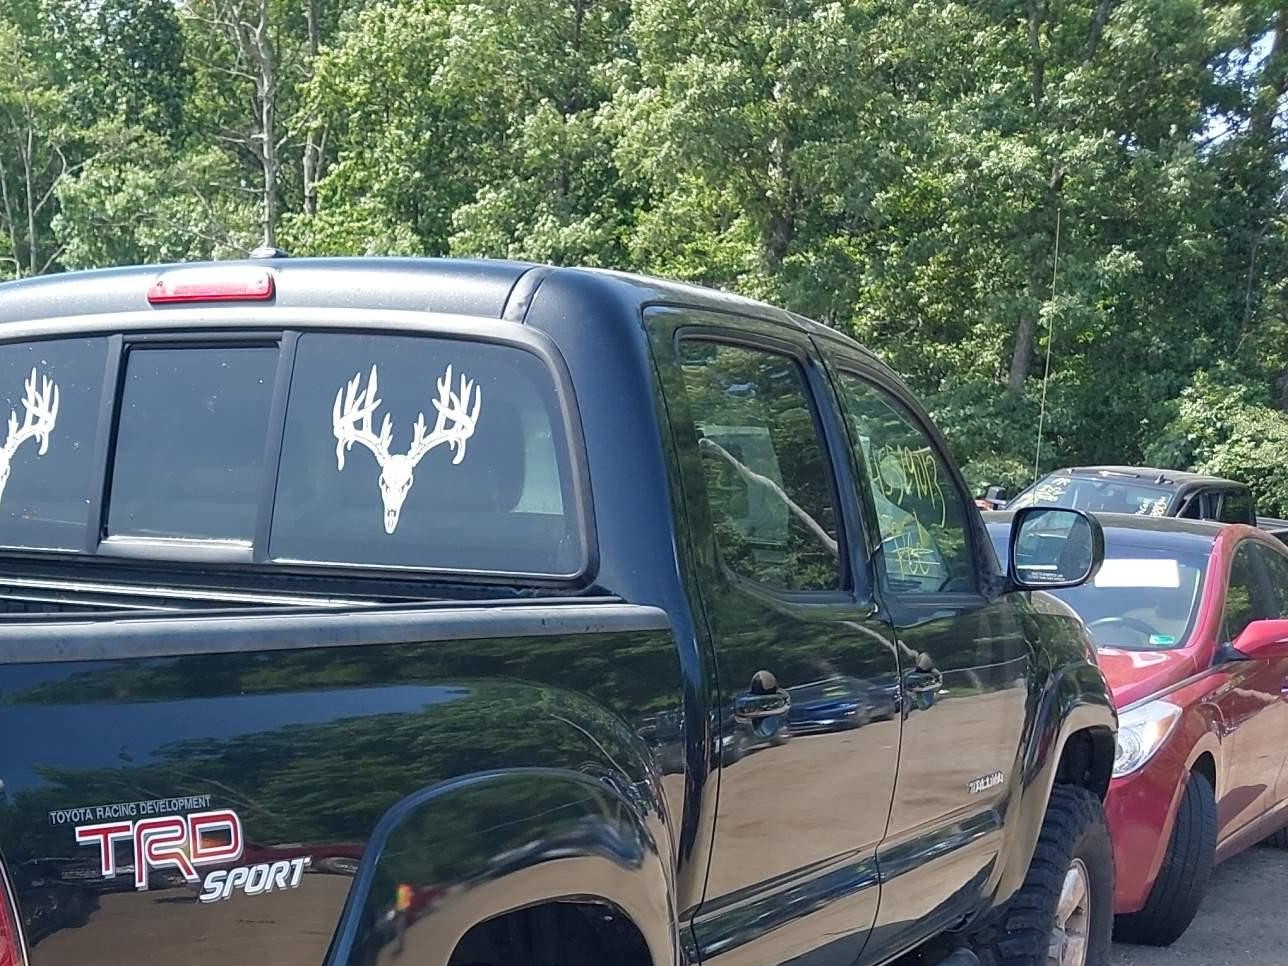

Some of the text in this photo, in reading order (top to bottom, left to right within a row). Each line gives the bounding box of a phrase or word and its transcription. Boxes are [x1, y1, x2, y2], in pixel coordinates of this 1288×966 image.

[50, 795, 212, 825] TOYOTA RACING DEVELOPMENT
[75, 809, 244, 890] TRD
[199, 857, 313, 903] SPORT
